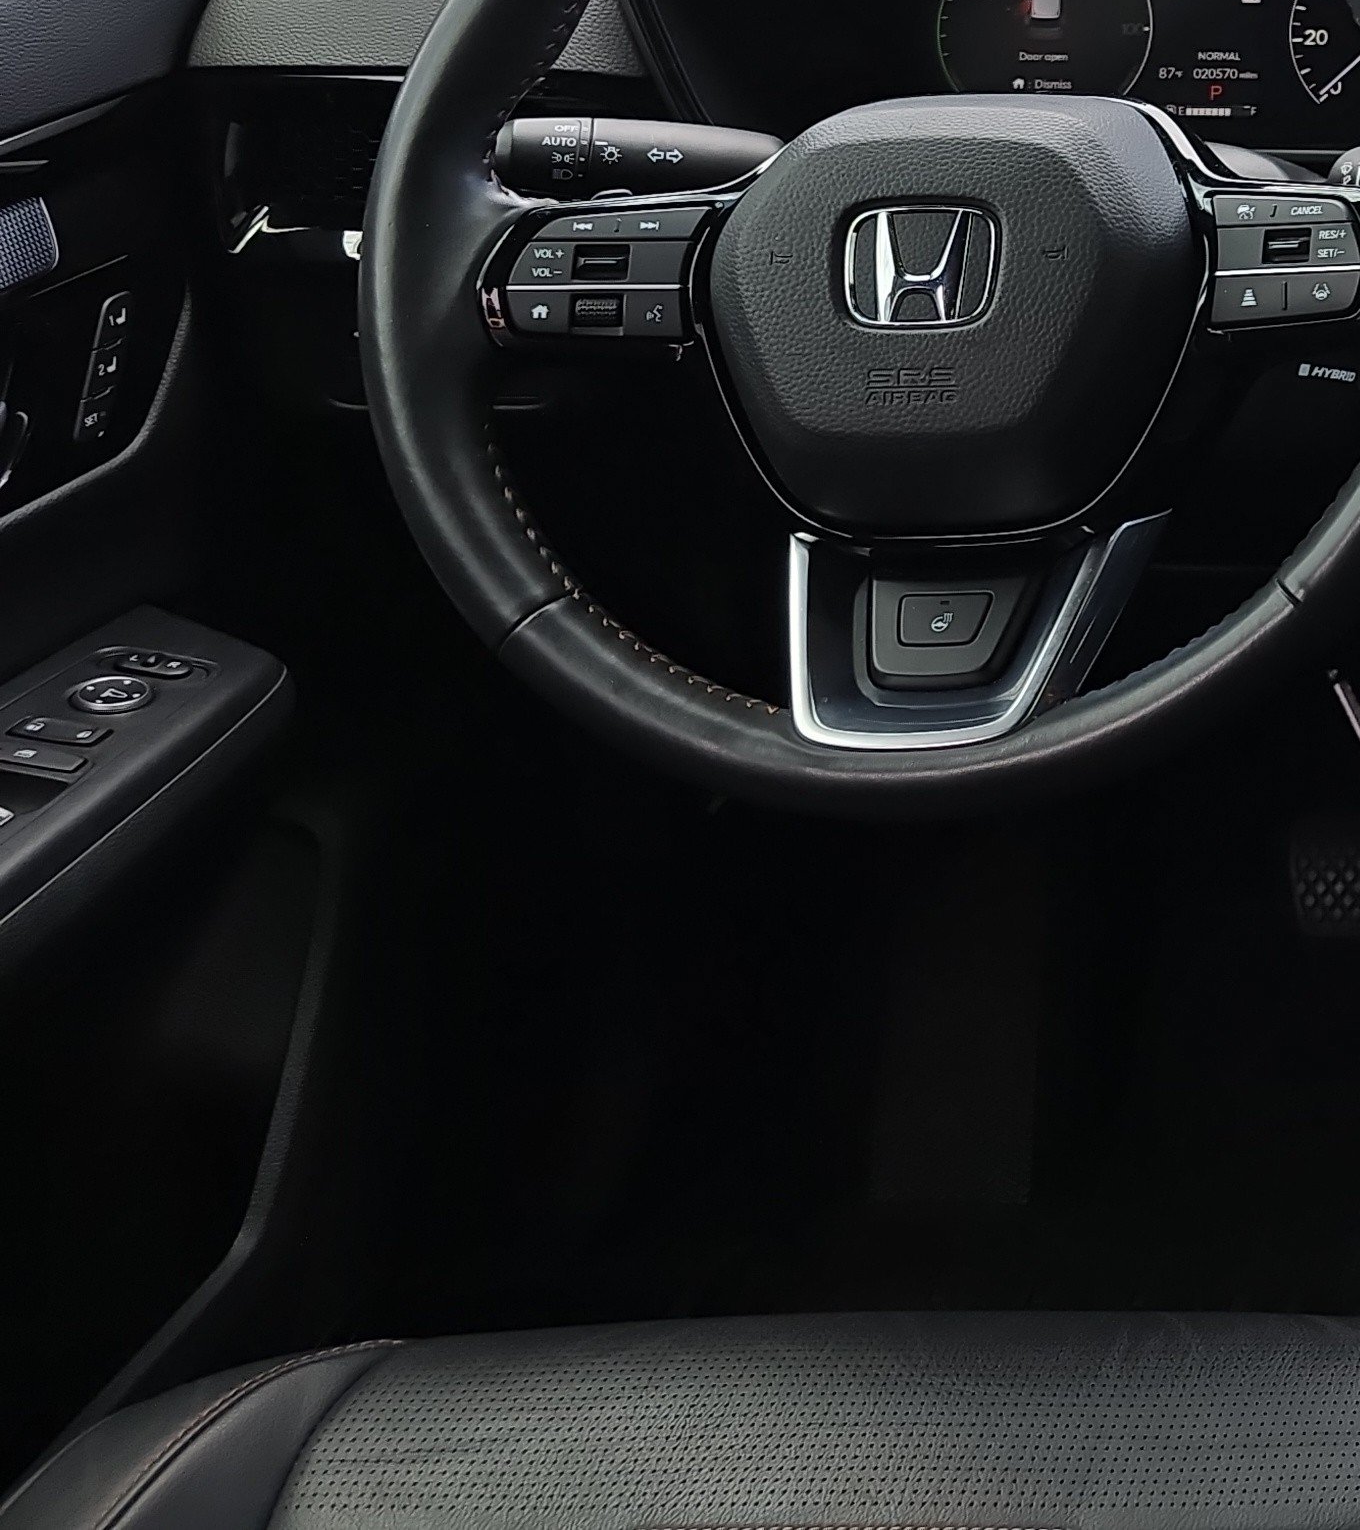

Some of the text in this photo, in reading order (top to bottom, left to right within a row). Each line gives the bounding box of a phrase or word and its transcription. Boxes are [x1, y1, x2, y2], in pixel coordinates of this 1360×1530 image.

[1303, 29, 1329, 46] 20
[1019, 51, 1069, 63] Door open
[1197, 51, 1241, 62] NORMAL
[1193, 68, 1238, 80] 020570
[1034, 78, 1073, 90] Dismiss
[1210, 86, 1223, 101] P
[541, 136, 577, 147] AUTO
[1290, 205, 1324, 216] CANCEL
[867, 367, 957, 387] SRS
[1311, 366, 1357, 383] HYBRID
[865, 389, 959, 406] AIRBAG
